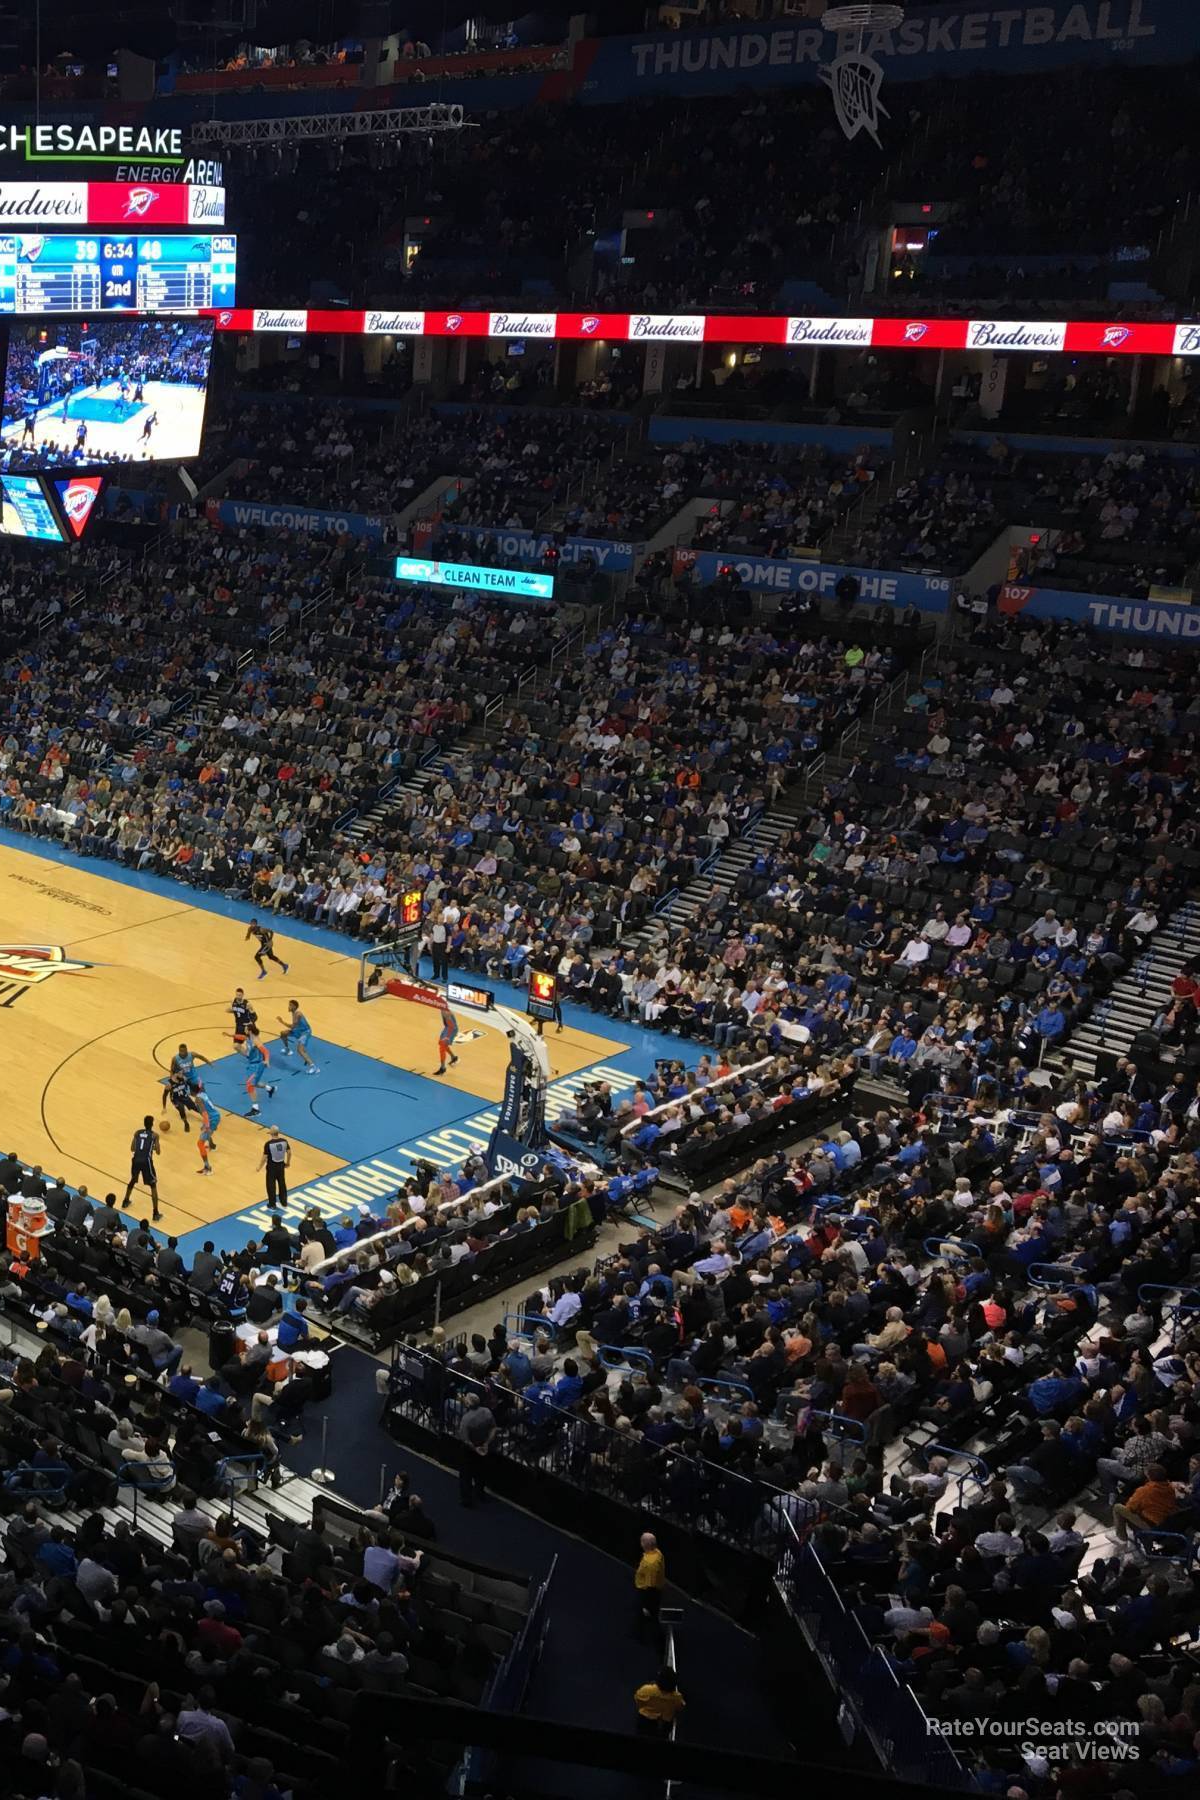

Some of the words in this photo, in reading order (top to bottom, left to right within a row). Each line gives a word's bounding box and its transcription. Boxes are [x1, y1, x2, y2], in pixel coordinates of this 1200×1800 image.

[632, 28, 824, 77] THUNDER
[836, 0, 1157, 57] BASKETBALL
[115, 165, 181, 183] ENERGY
[183, 158, 223, 186] ARENA
[75, 241, 98, 261] 39
[104, 244, 133, 260] 6:34
[213, 239, 235, 252] ORL
[105, 281, 131, 297] 2nd
[234, 505, 320, 531] WELCOME
[324, 515, 349, 536] TO
[613, 543, 632, 555] 105
[444, 569, 481, 585] CLEAN
[483, 574, 516, 588] TEAM
[797, 571, 837, 592] OF
[851, 575, 898, 600] HE
[923, 578, 950, 592] 106
[1003, 587, 1030, 601] 107
[404, 903, 419, 923] 16
[504, 1074, 517, 1122] DRAFTKINGS
[16, 1233, 28, 1251] G
[219, 1279, 235, 1296] 24
